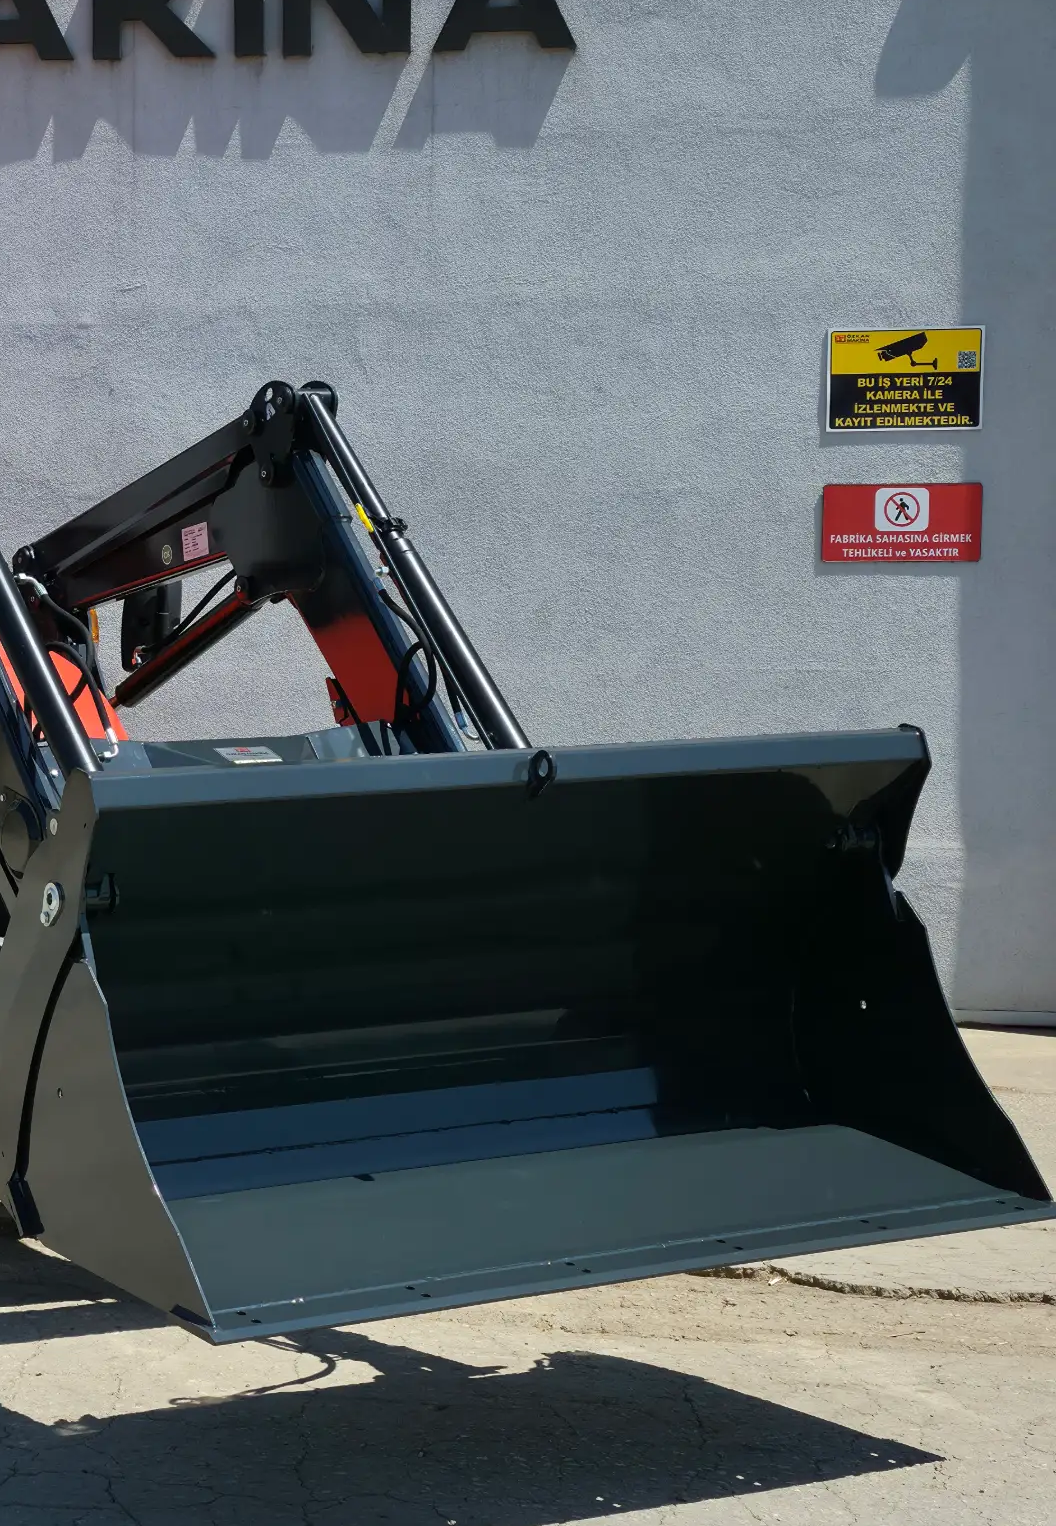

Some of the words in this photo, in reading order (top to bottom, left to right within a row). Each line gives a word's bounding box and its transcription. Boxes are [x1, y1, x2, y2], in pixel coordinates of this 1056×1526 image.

[857, 378, 875, 388] BU
[878, 376, 891, 389] İŞ
[894, 376, 924, 387] YERİ
[927, 376, 953, 386] 7/24
[866, 390, 920, 401] KAMERA
[923, 388, 943, 400] İLE
[854, 402, 935, 414] İZLENMEKTE
[938, 403, 955, 412] VE
[835, 417, 873, 427] KAYIT
[876, 415, 974, 426] EDİLMEKTEDİR.
[830, 533, 873, 544] FABRİKA
[876, 534, 930, 543] SAHASINA
[932, 532, 972, 543] GİRMEK
[842, 546, 893, 557] TEHLİKELİ
[909, 548, 960, 557] YASAKTIR
